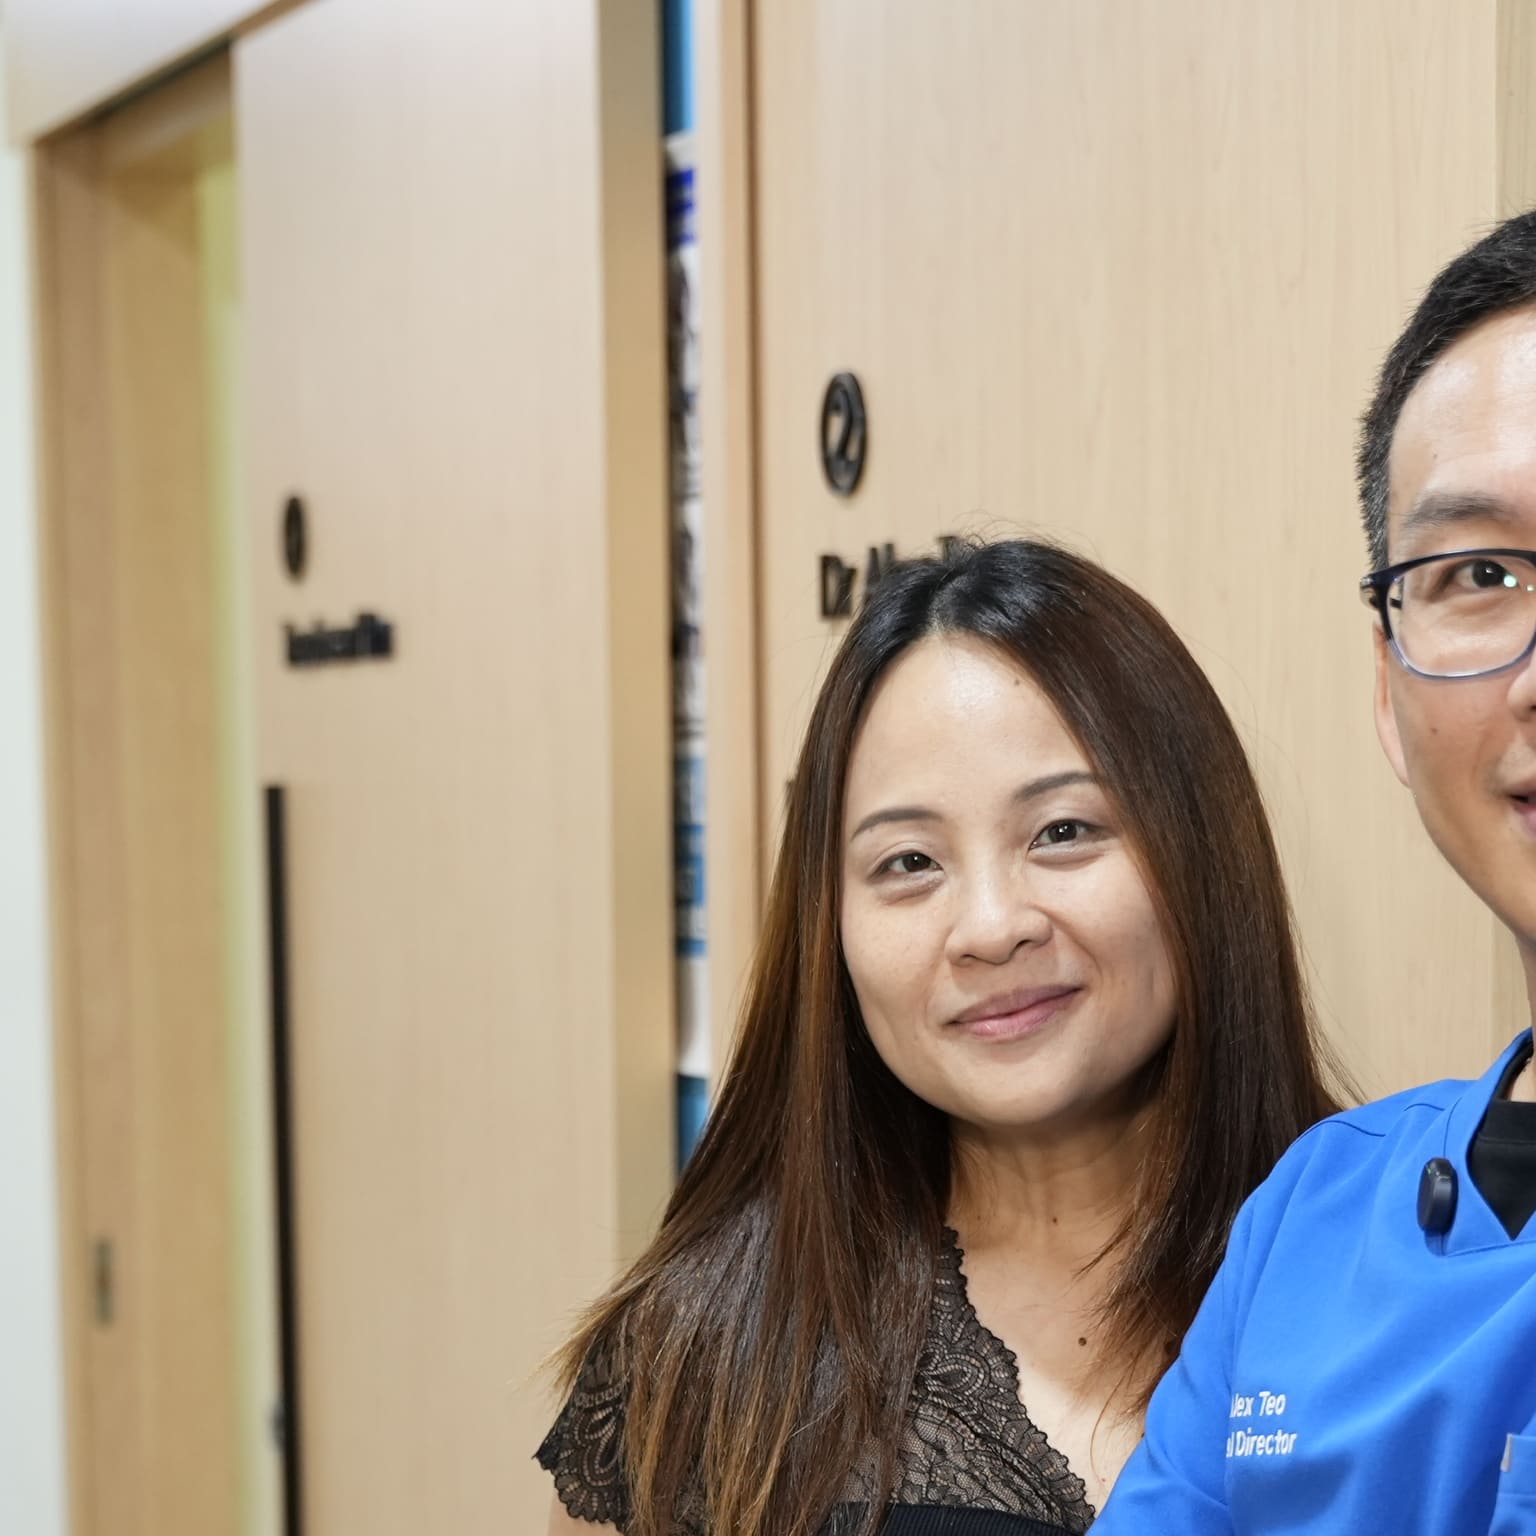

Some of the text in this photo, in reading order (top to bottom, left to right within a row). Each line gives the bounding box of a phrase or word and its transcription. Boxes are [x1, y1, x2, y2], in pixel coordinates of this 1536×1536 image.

[1230, 1391, 1286, 1418] lex Teo
[1235, 1427, 1297, 1456] Director
